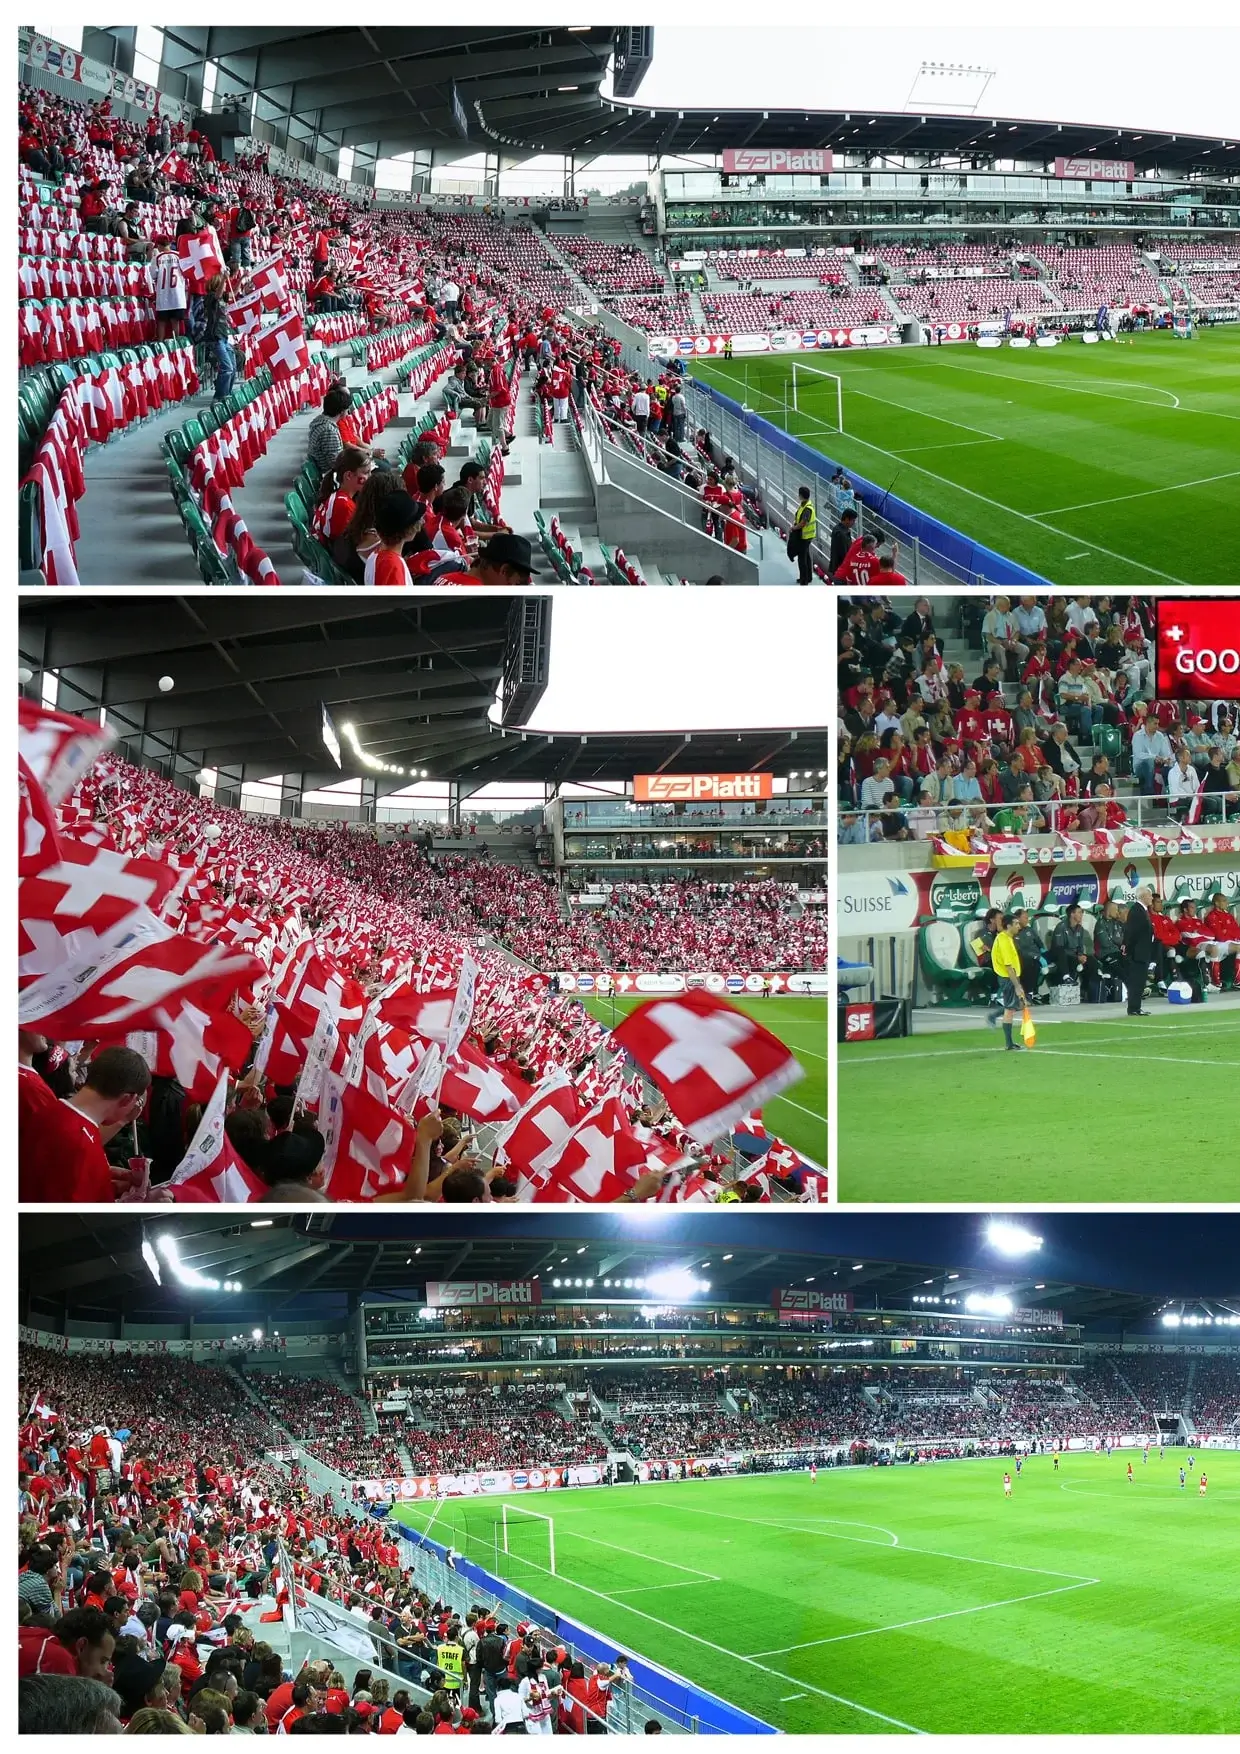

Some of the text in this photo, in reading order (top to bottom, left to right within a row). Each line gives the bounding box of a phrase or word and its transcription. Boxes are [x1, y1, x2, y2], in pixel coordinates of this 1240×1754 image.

[772, 151, 824, 170] Piatti
[1090, 160, 1128, 179] Piatti
[161, 266, 178, 289] 16
[693, 775, 760, 797] Piatti
[847, 813, 871, 832] SF
[844, 895, 892, 914] SUISSE
[933, 885, 979, 906] Calsberg
[477, 1282, 531, 1303] Piatti
[808, 1291, 847, 1310] Piatti
[1033, 1309, 1060, 1325] Piatti
[441, 1651, 459, 1660] STAFF
[444, 1662, 454, 1671] 26
